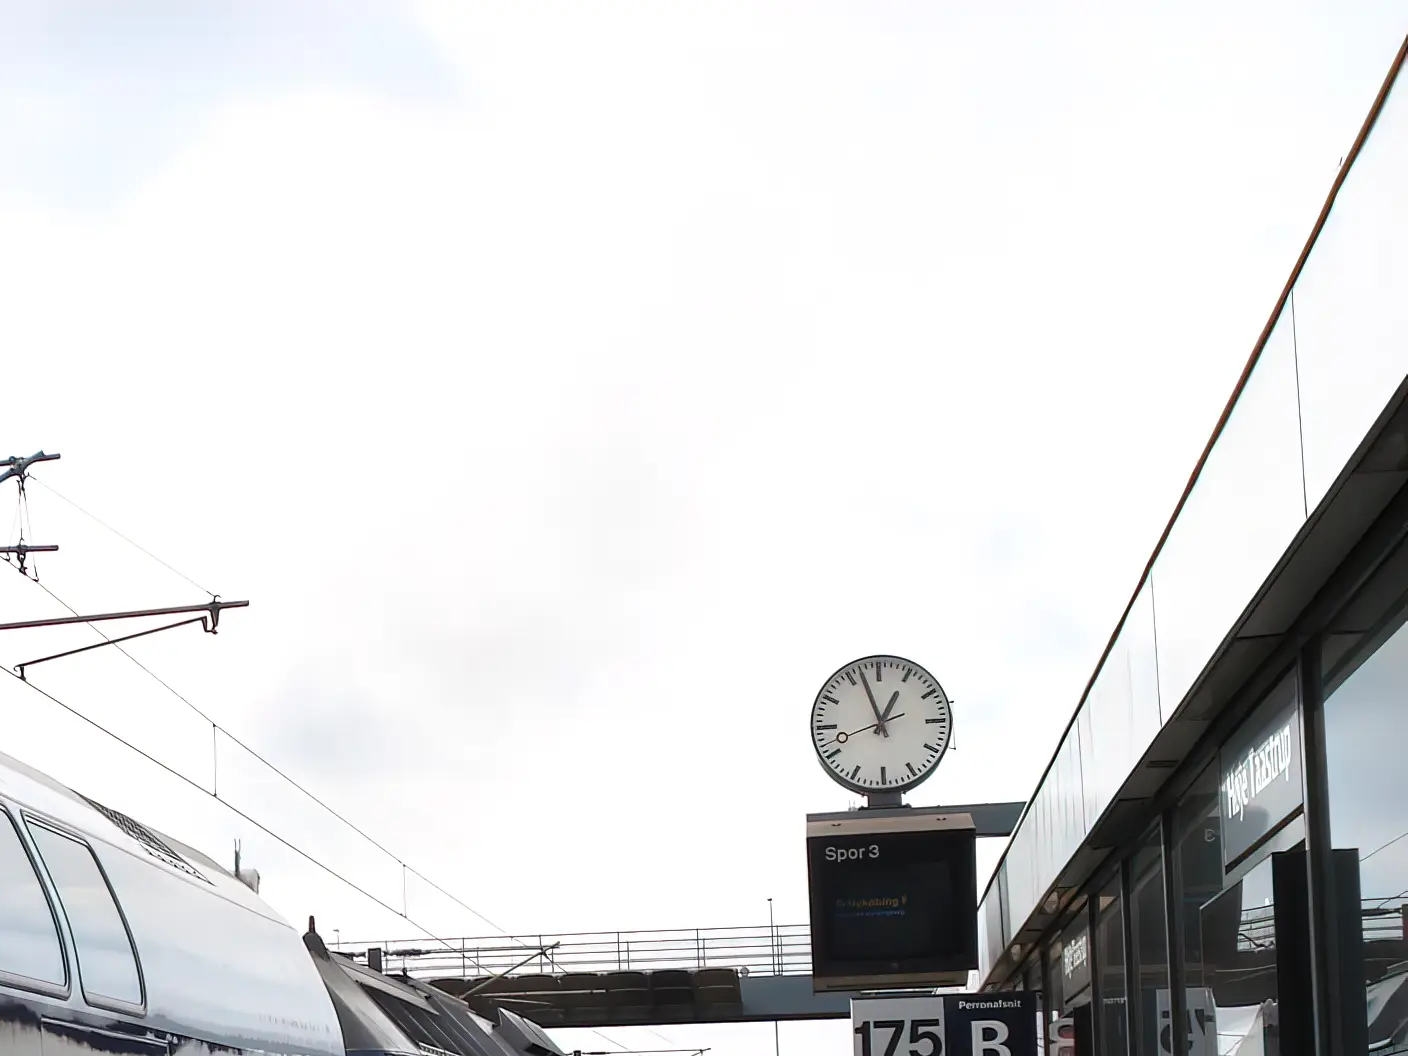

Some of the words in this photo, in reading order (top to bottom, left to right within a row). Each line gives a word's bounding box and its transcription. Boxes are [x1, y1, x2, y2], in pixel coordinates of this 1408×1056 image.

[825, 846, 866, 863] Spor
[868, 844, 880, 859] 3
[958, 999, 1022, 1010] Perronafsnit
